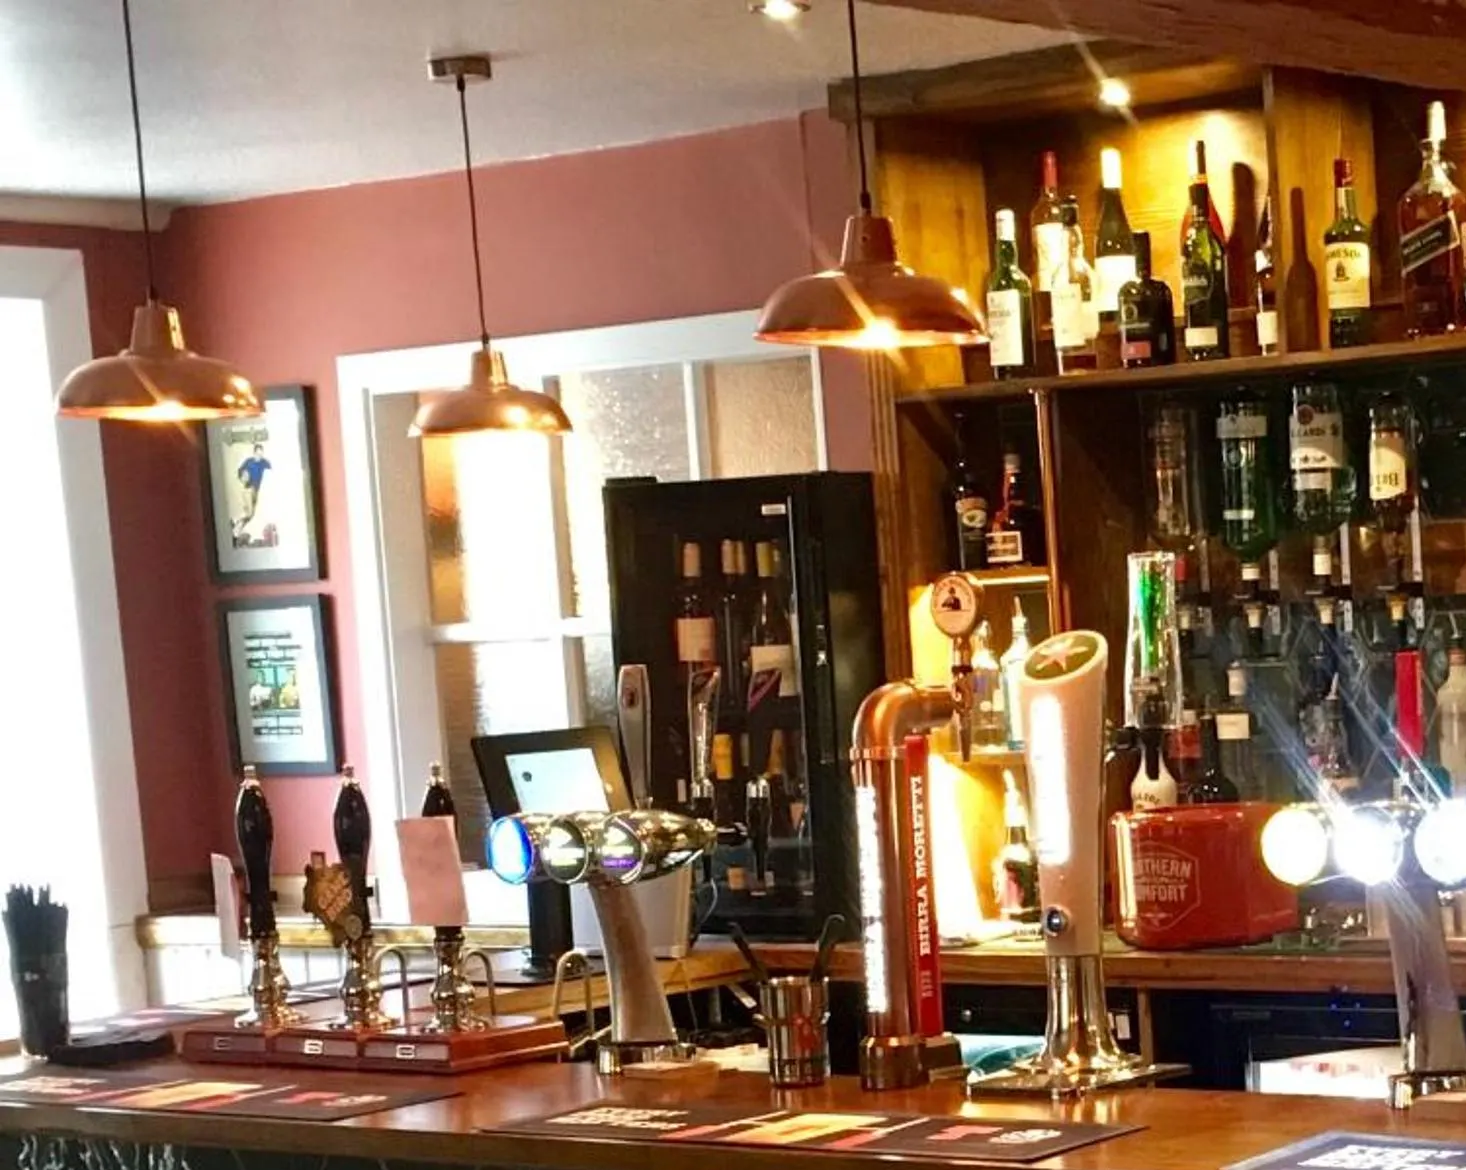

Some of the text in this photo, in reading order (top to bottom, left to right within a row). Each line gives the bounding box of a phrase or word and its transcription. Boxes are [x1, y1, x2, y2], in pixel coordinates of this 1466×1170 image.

[909, 775, 927, 879] MORETTI
[1134, 858, 1192, 878] UTHERN
[1135, 884, 1188, 901] MFORT
[916, 884, 931, 957] BIRRA
